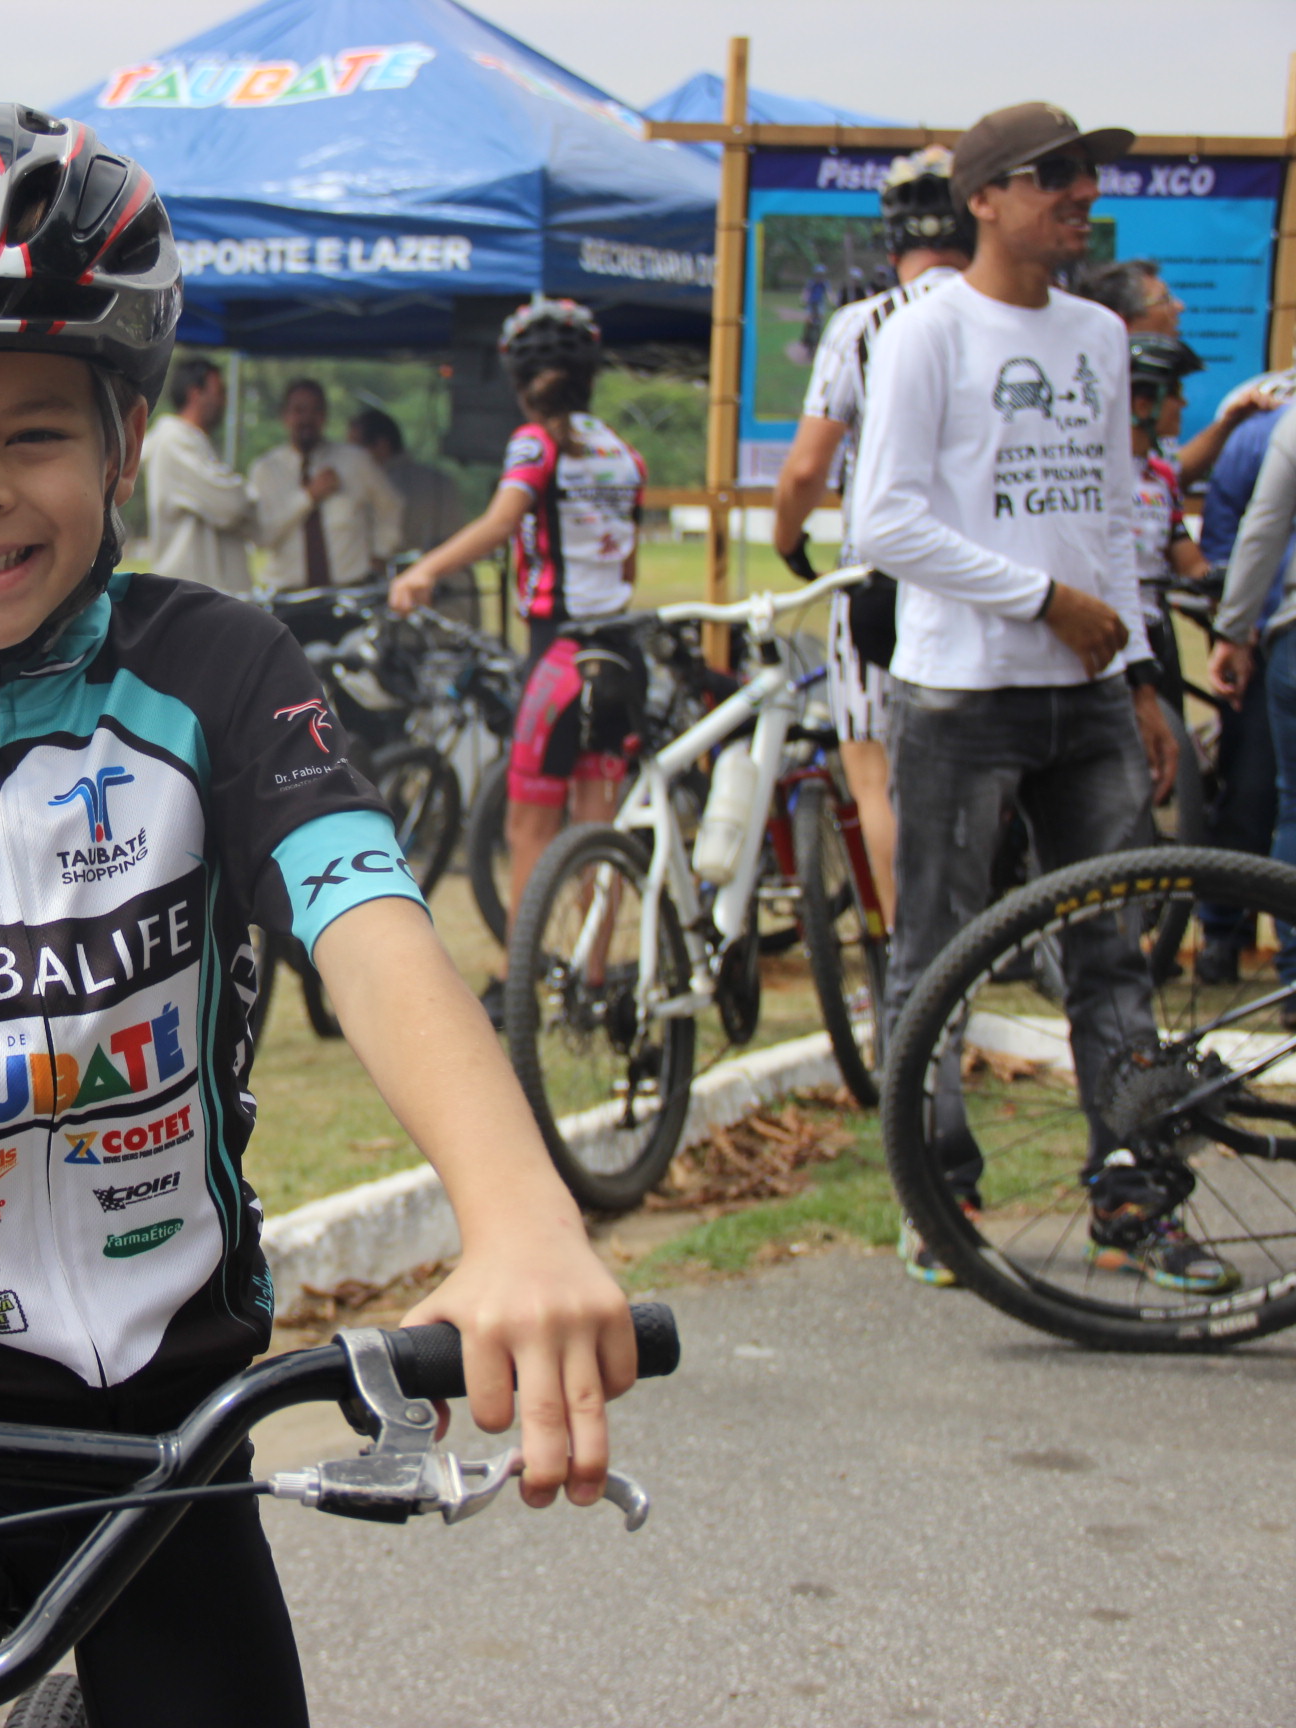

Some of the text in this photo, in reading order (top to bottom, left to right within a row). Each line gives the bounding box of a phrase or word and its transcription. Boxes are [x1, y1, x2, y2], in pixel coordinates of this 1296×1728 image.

[1147, 164, 1215, 196] XCO
[179, 235, 471, 275] SPORTE E LAZER
[994, 492, 1016, 519] A
[1025, 486, 1104, 515] GENTE
[274, 773, 291, 785] Dr.
[292, 765, 323, 780] Fabio
[56, 826, 148, 869] TAUBATÉ
[60, 846, 149, 885] SHOPPING
[7, 1033, 27, 1047] DE
[101, 1104, 191, 1155] COTET
